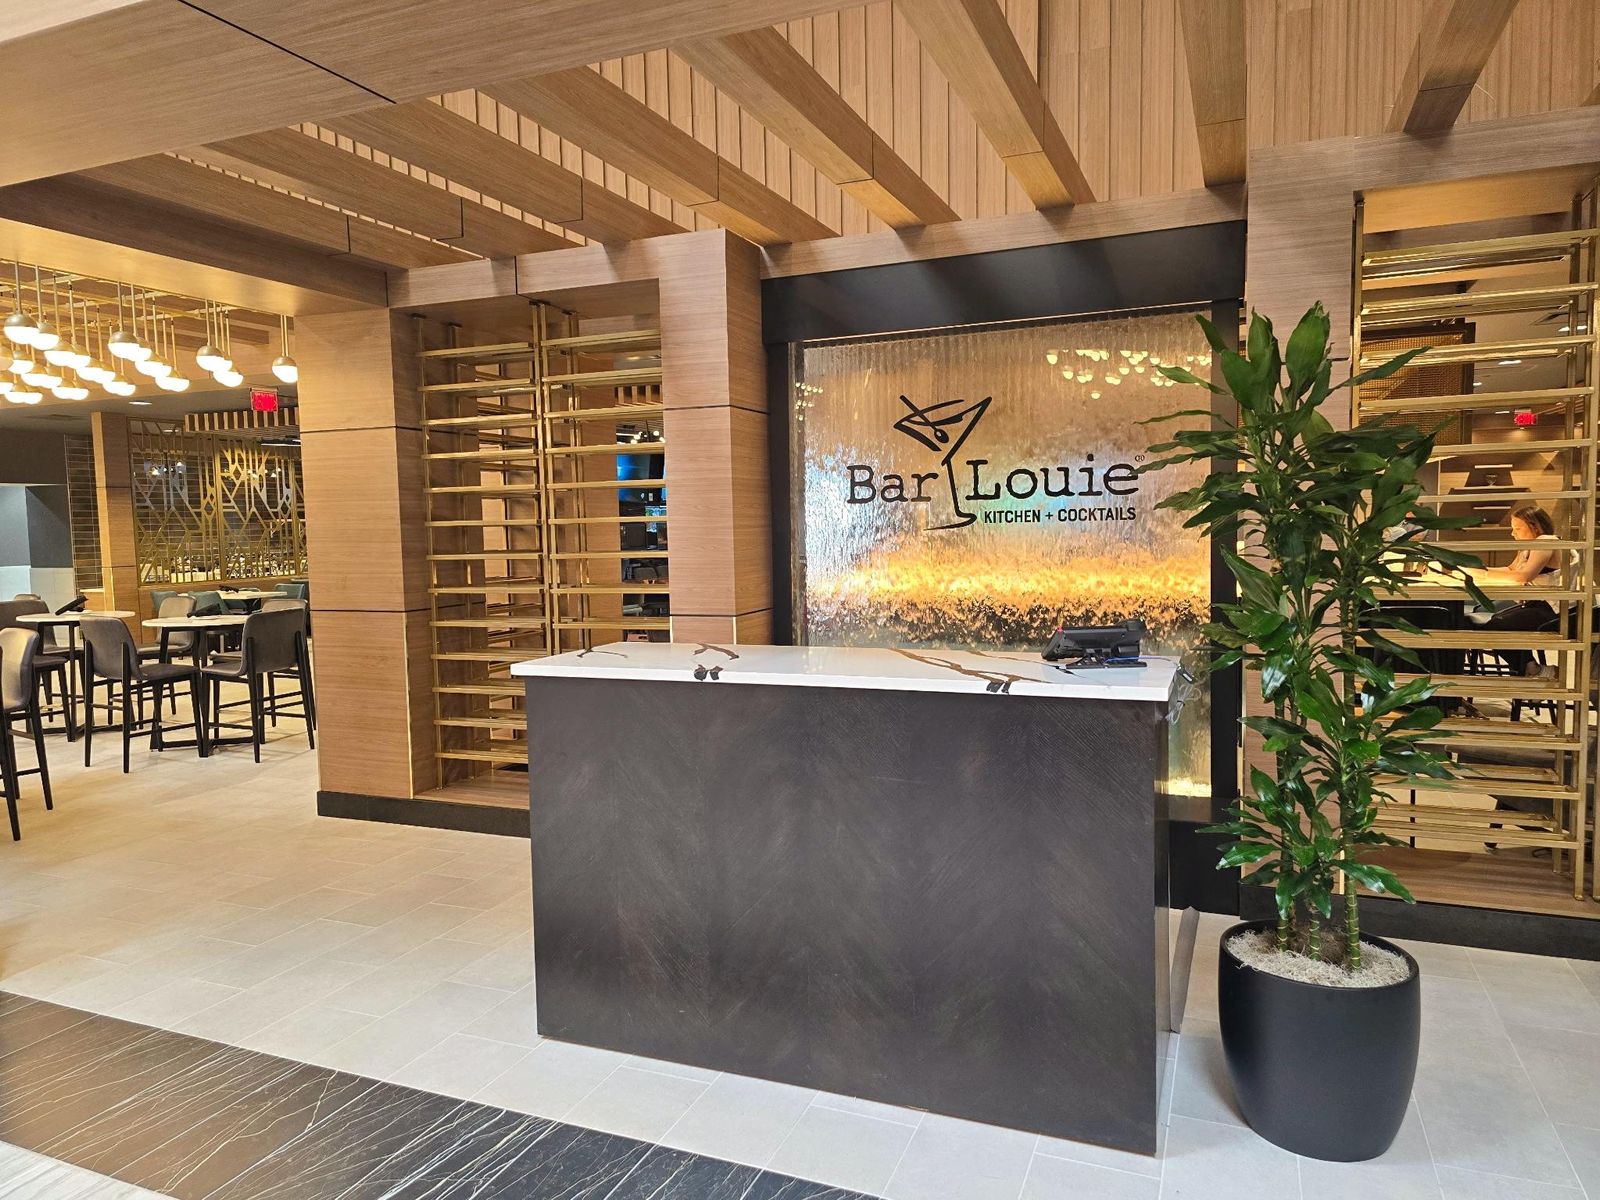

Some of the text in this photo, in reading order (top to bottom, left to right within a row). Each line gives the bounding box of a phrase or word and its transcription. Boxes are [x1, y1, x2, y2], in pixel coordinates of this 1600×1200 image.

[846, 464, 939, 504] Bar
[965, 453, 1139, 501] Louie
[983, 509, 1041, 524] KITCHEN
[1057, 507, 1137, 523] COCKTAILS
